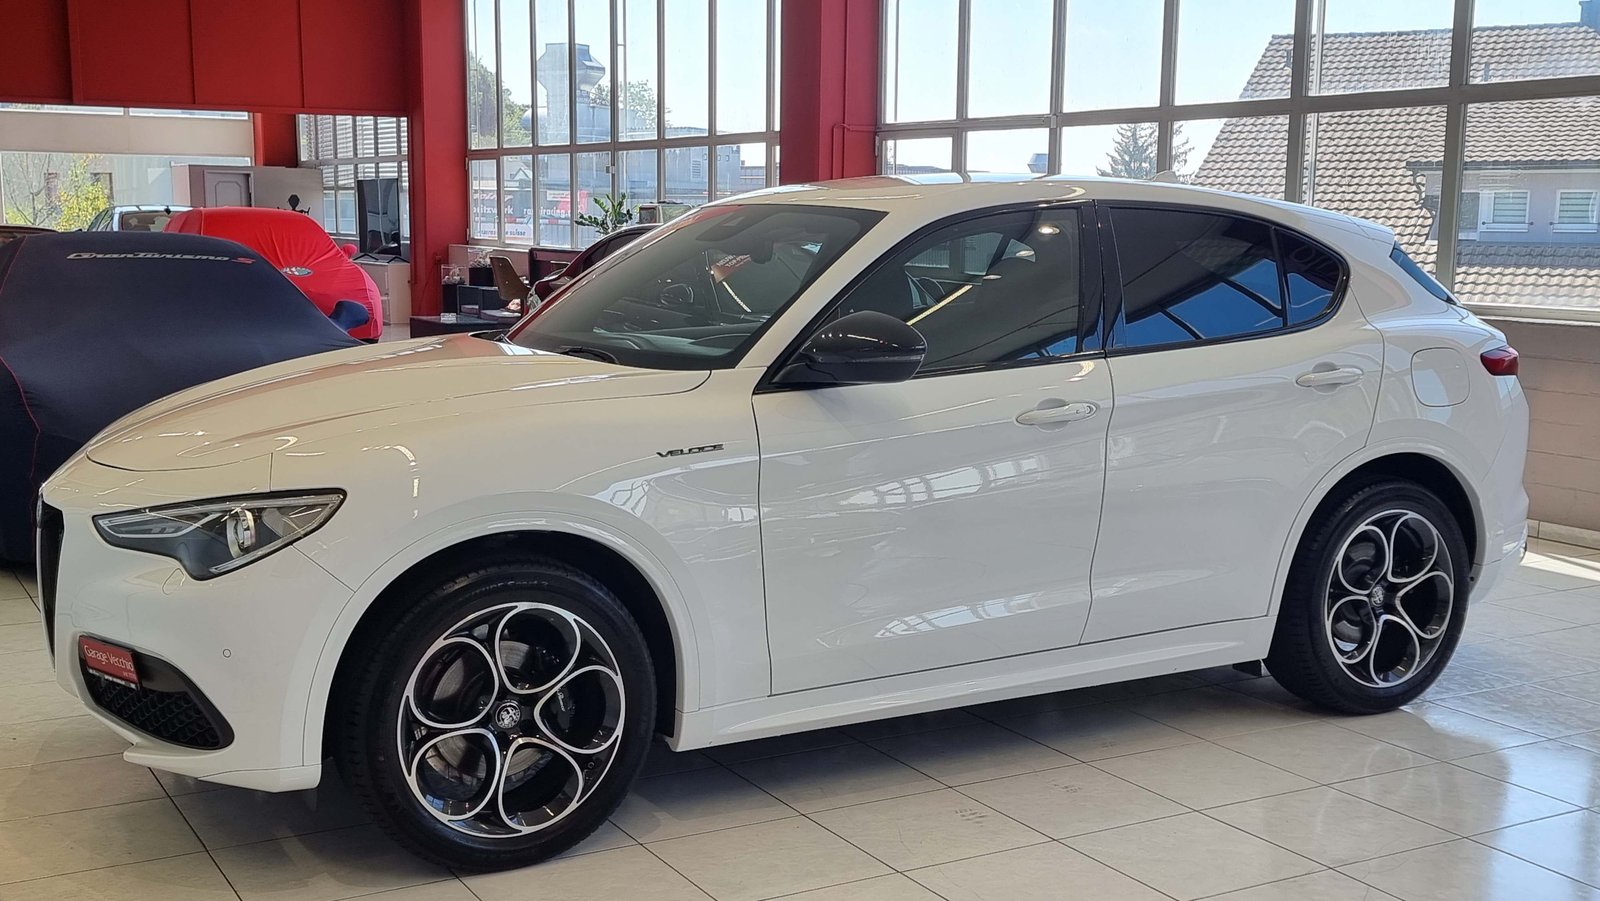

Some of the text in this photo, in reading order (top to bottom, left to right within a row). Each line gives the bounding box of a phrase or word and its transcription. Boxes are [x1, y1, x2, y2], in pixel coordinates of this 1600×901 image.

[656, 443, 724, 458] VELOCE
[84, 645, 134, 672] Garage Vecchio
